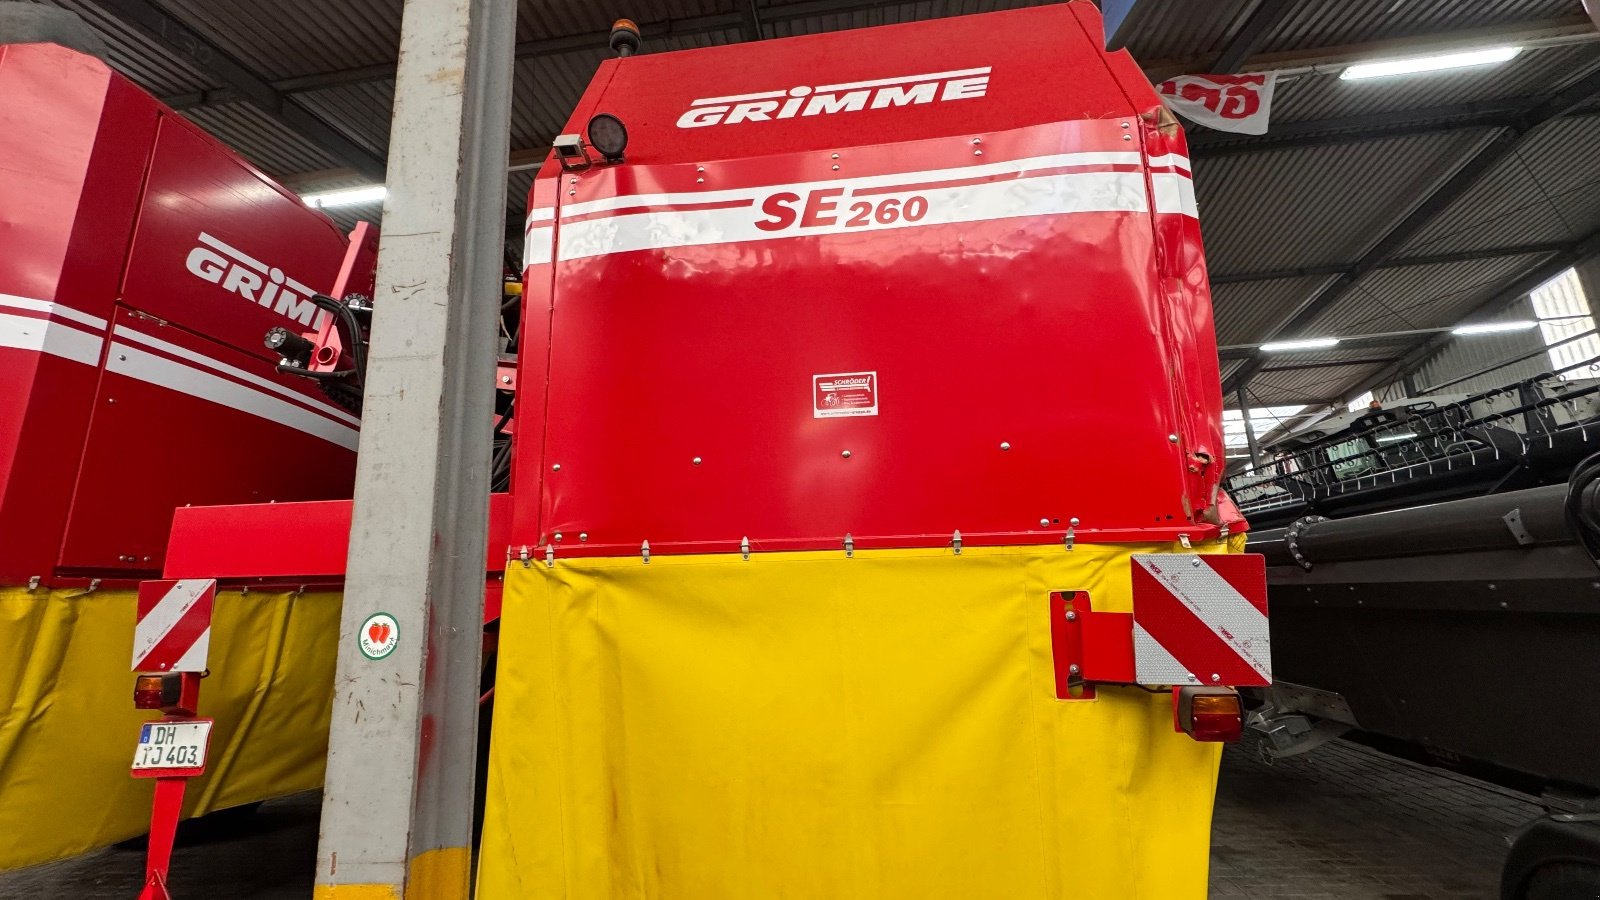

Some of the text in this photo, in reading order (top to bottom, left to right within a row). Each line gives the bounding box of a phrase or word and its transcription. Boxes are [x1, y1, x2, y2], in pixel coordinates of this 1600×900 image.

[676, 75, 991, 129] GRIMME
[754, 187, 929, 232] SE 260
[155, 727, 176, 744] DH
[166, 746, 197, 764] 403
